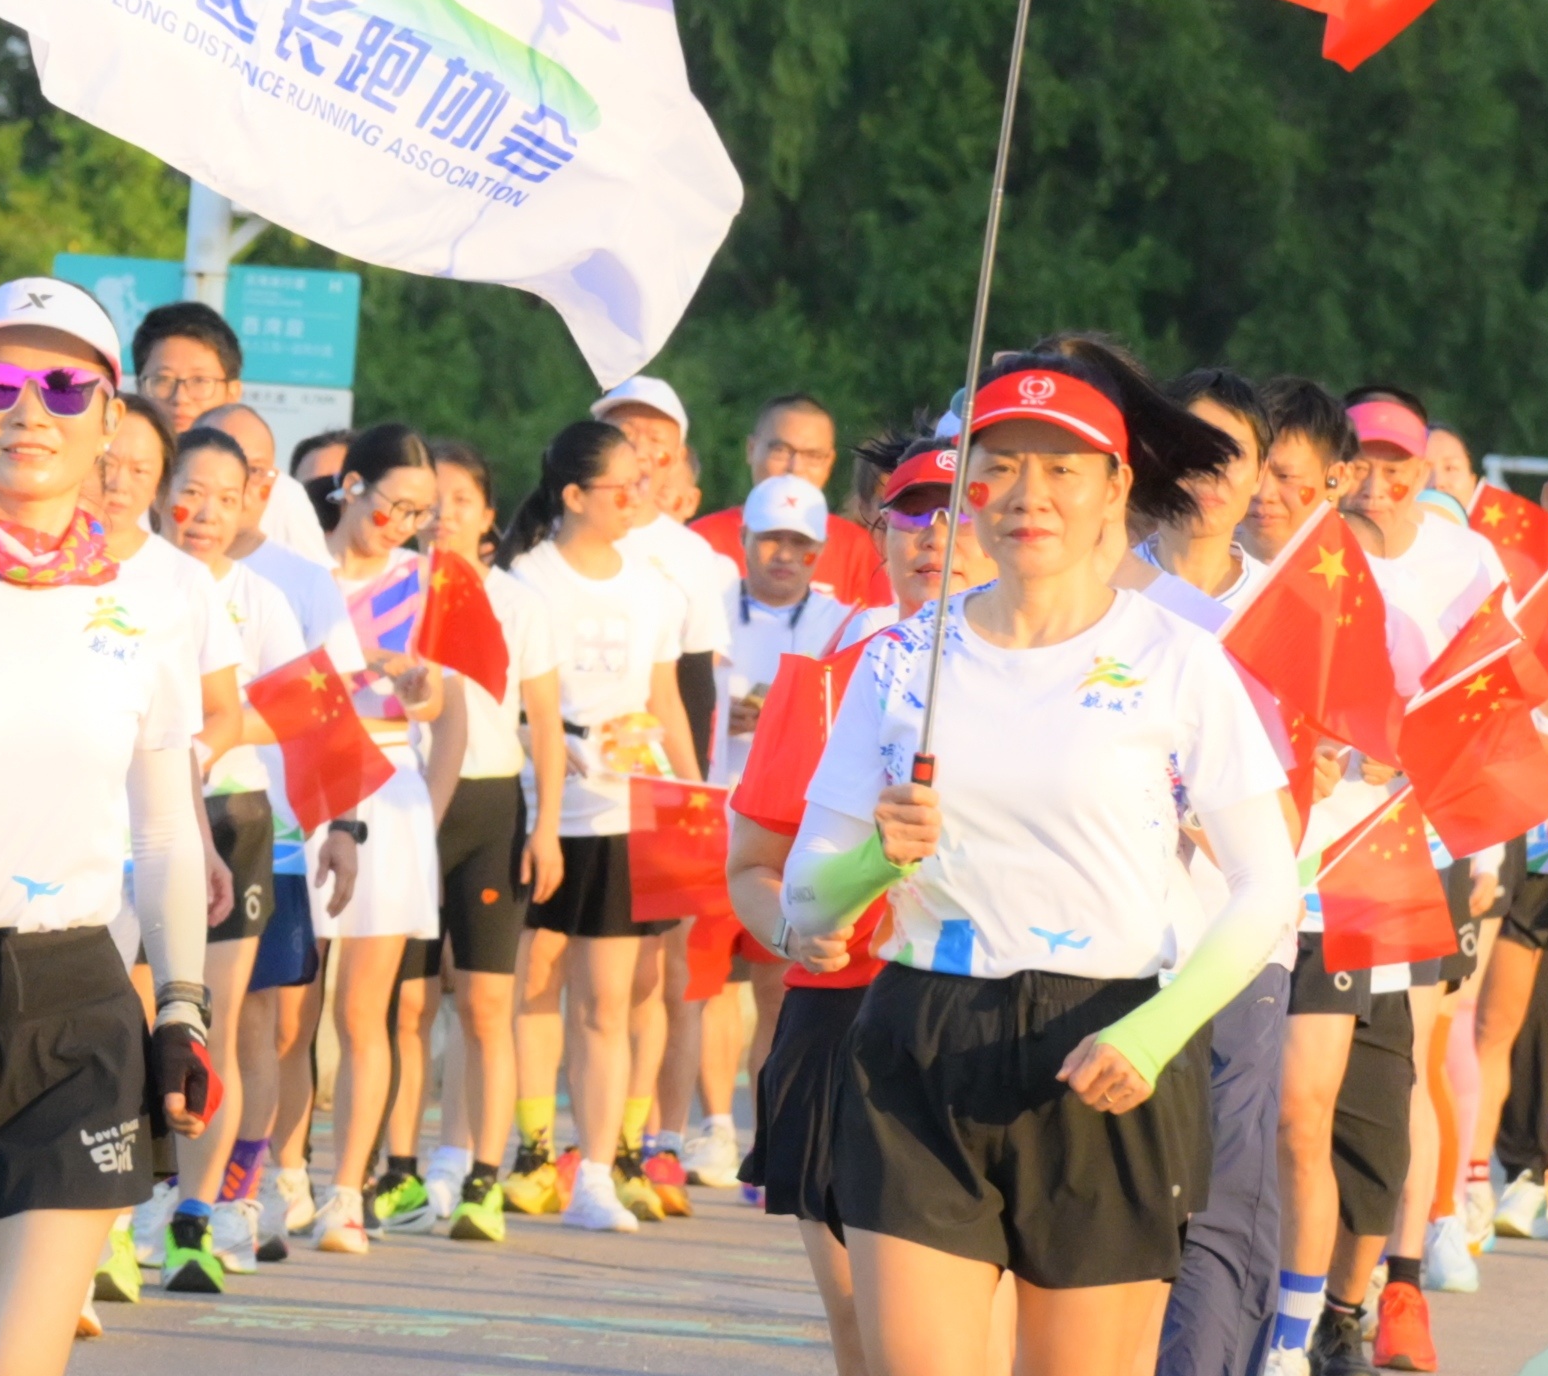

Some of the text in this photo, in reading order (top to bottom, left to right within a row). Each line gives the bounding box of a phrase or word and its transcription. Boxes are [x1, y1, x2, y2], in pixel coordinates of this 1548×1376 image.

[183, 20, 286, 99] DISTANCE
[285, 82, 384, 147] RUNNING
[383, 136, 530, 208] ASSOCIATION
